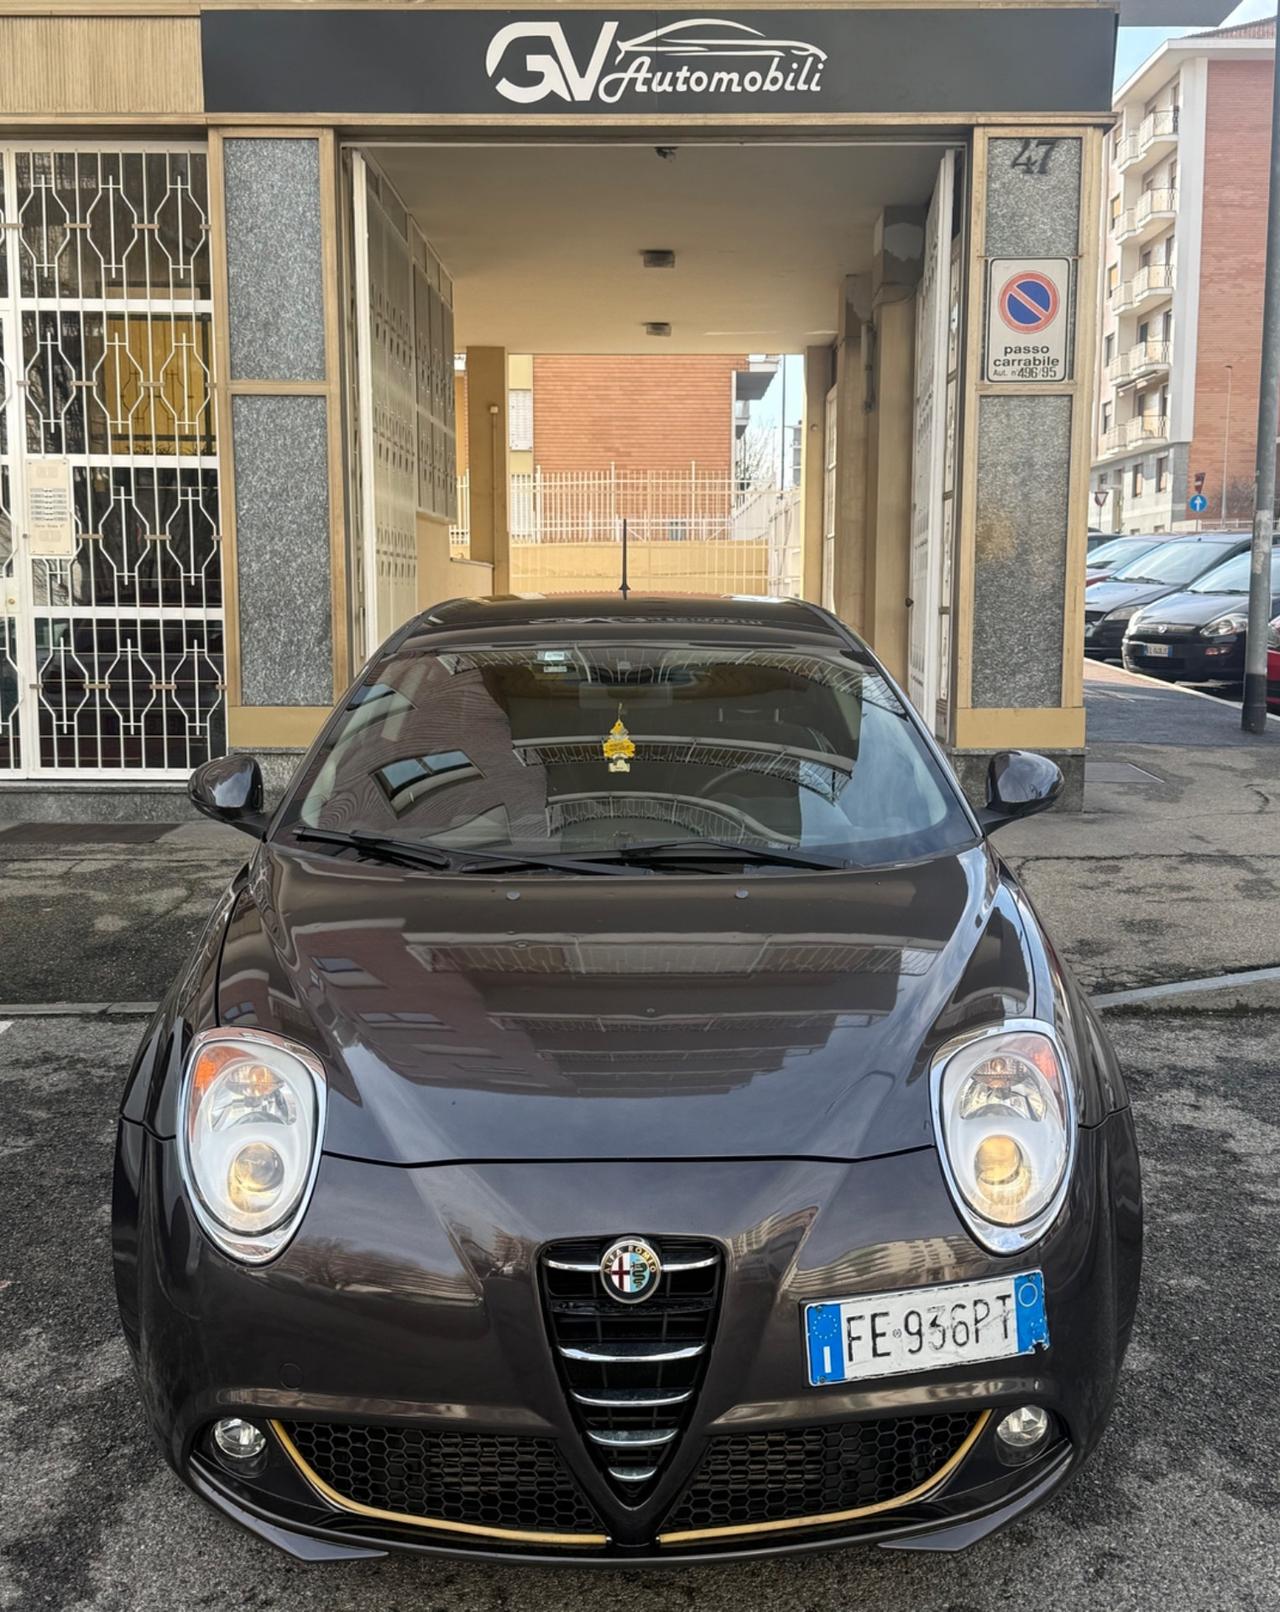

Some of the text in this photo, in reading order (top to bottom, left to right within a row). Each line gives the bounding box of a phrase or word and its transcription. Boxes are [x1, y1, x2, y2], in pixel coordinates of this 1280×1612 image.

[486, 21, 822, 103] GV Automobili
[1011, 139, 1057, 174] 47
[993, 356, 1060, 367] carrabile
[1004, 345, 1050, 357] passo
[603, 1249, 623, 1274] ALFA
